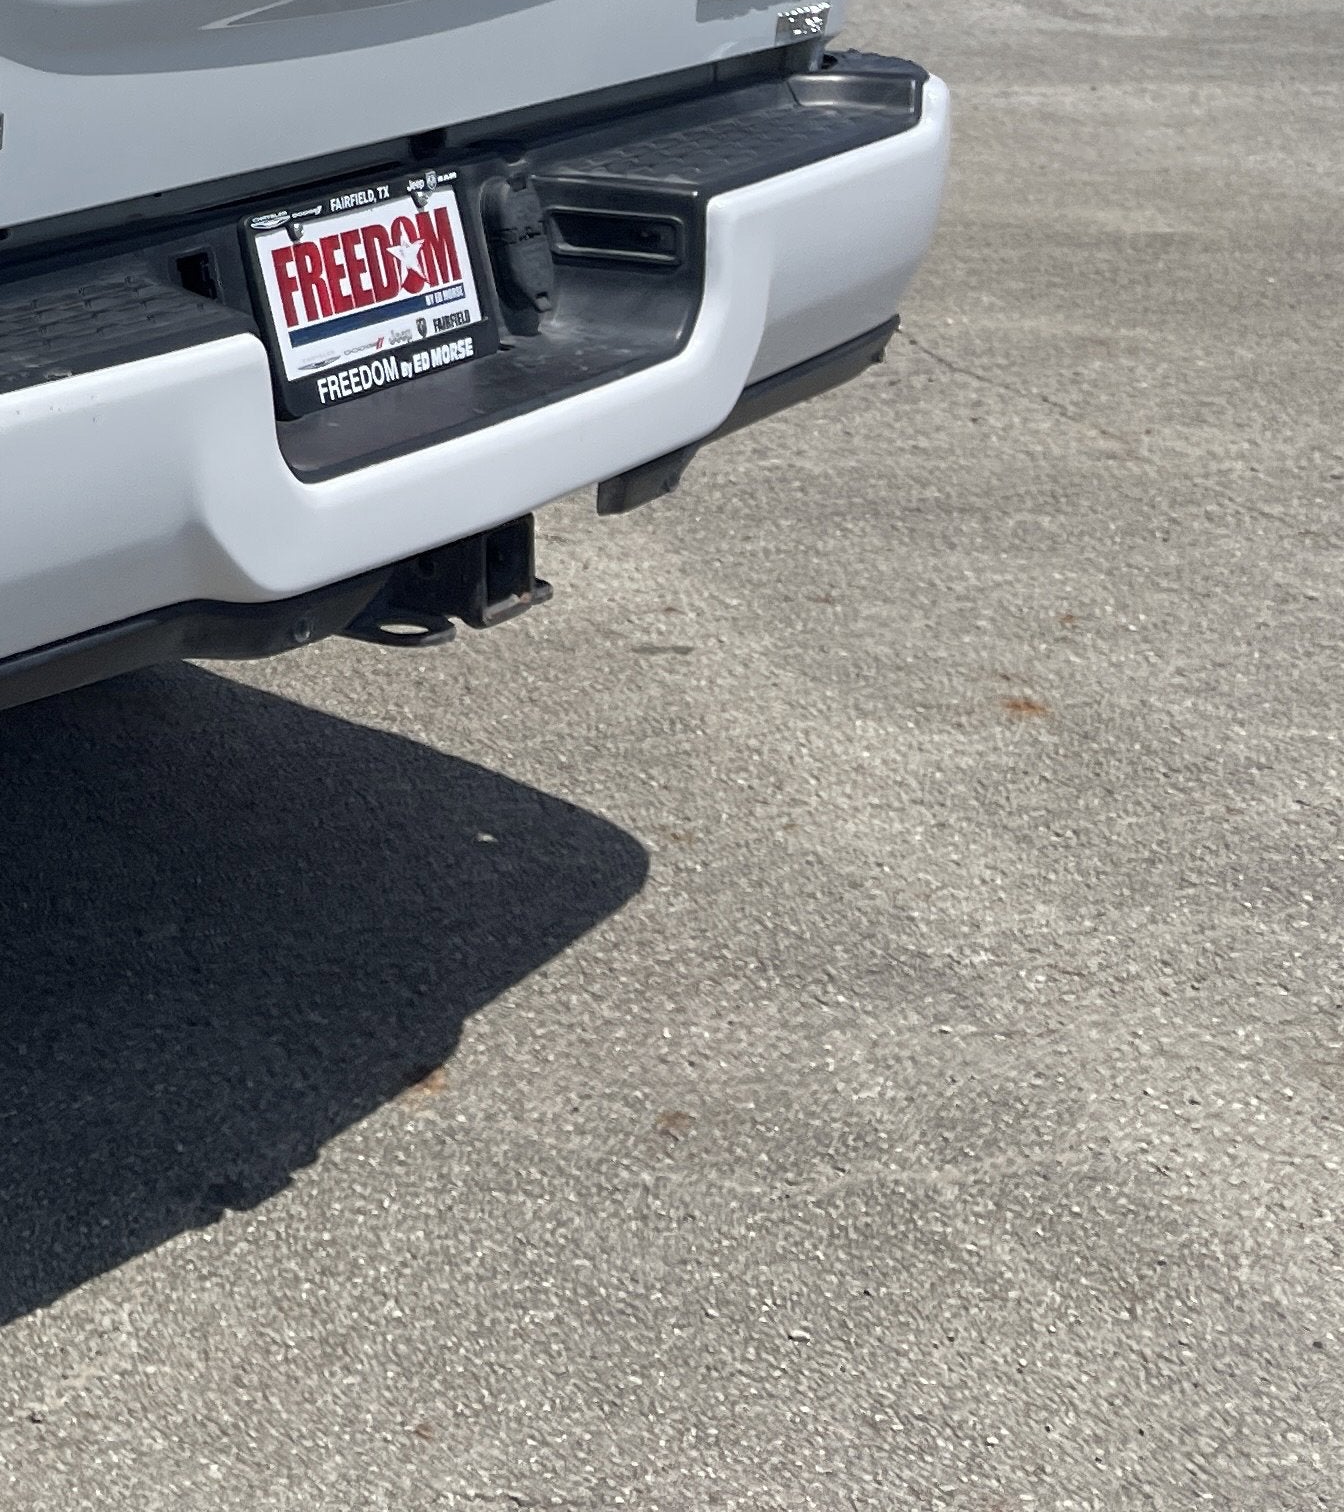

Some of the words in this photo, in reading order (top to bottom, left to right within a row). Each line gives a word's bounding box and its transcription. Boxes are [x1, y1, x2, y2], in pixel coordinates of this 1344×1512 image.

[330, 189, 377, 211] FAIRFIELD,
[376, 185, 390, 200] TX
[271, 207, 463, 328] FREEDOM
[317, 355, 400, 404] FREEDOM
[412, 350, 431, 374] ED
[429, 336, 474, 368] MORSE
